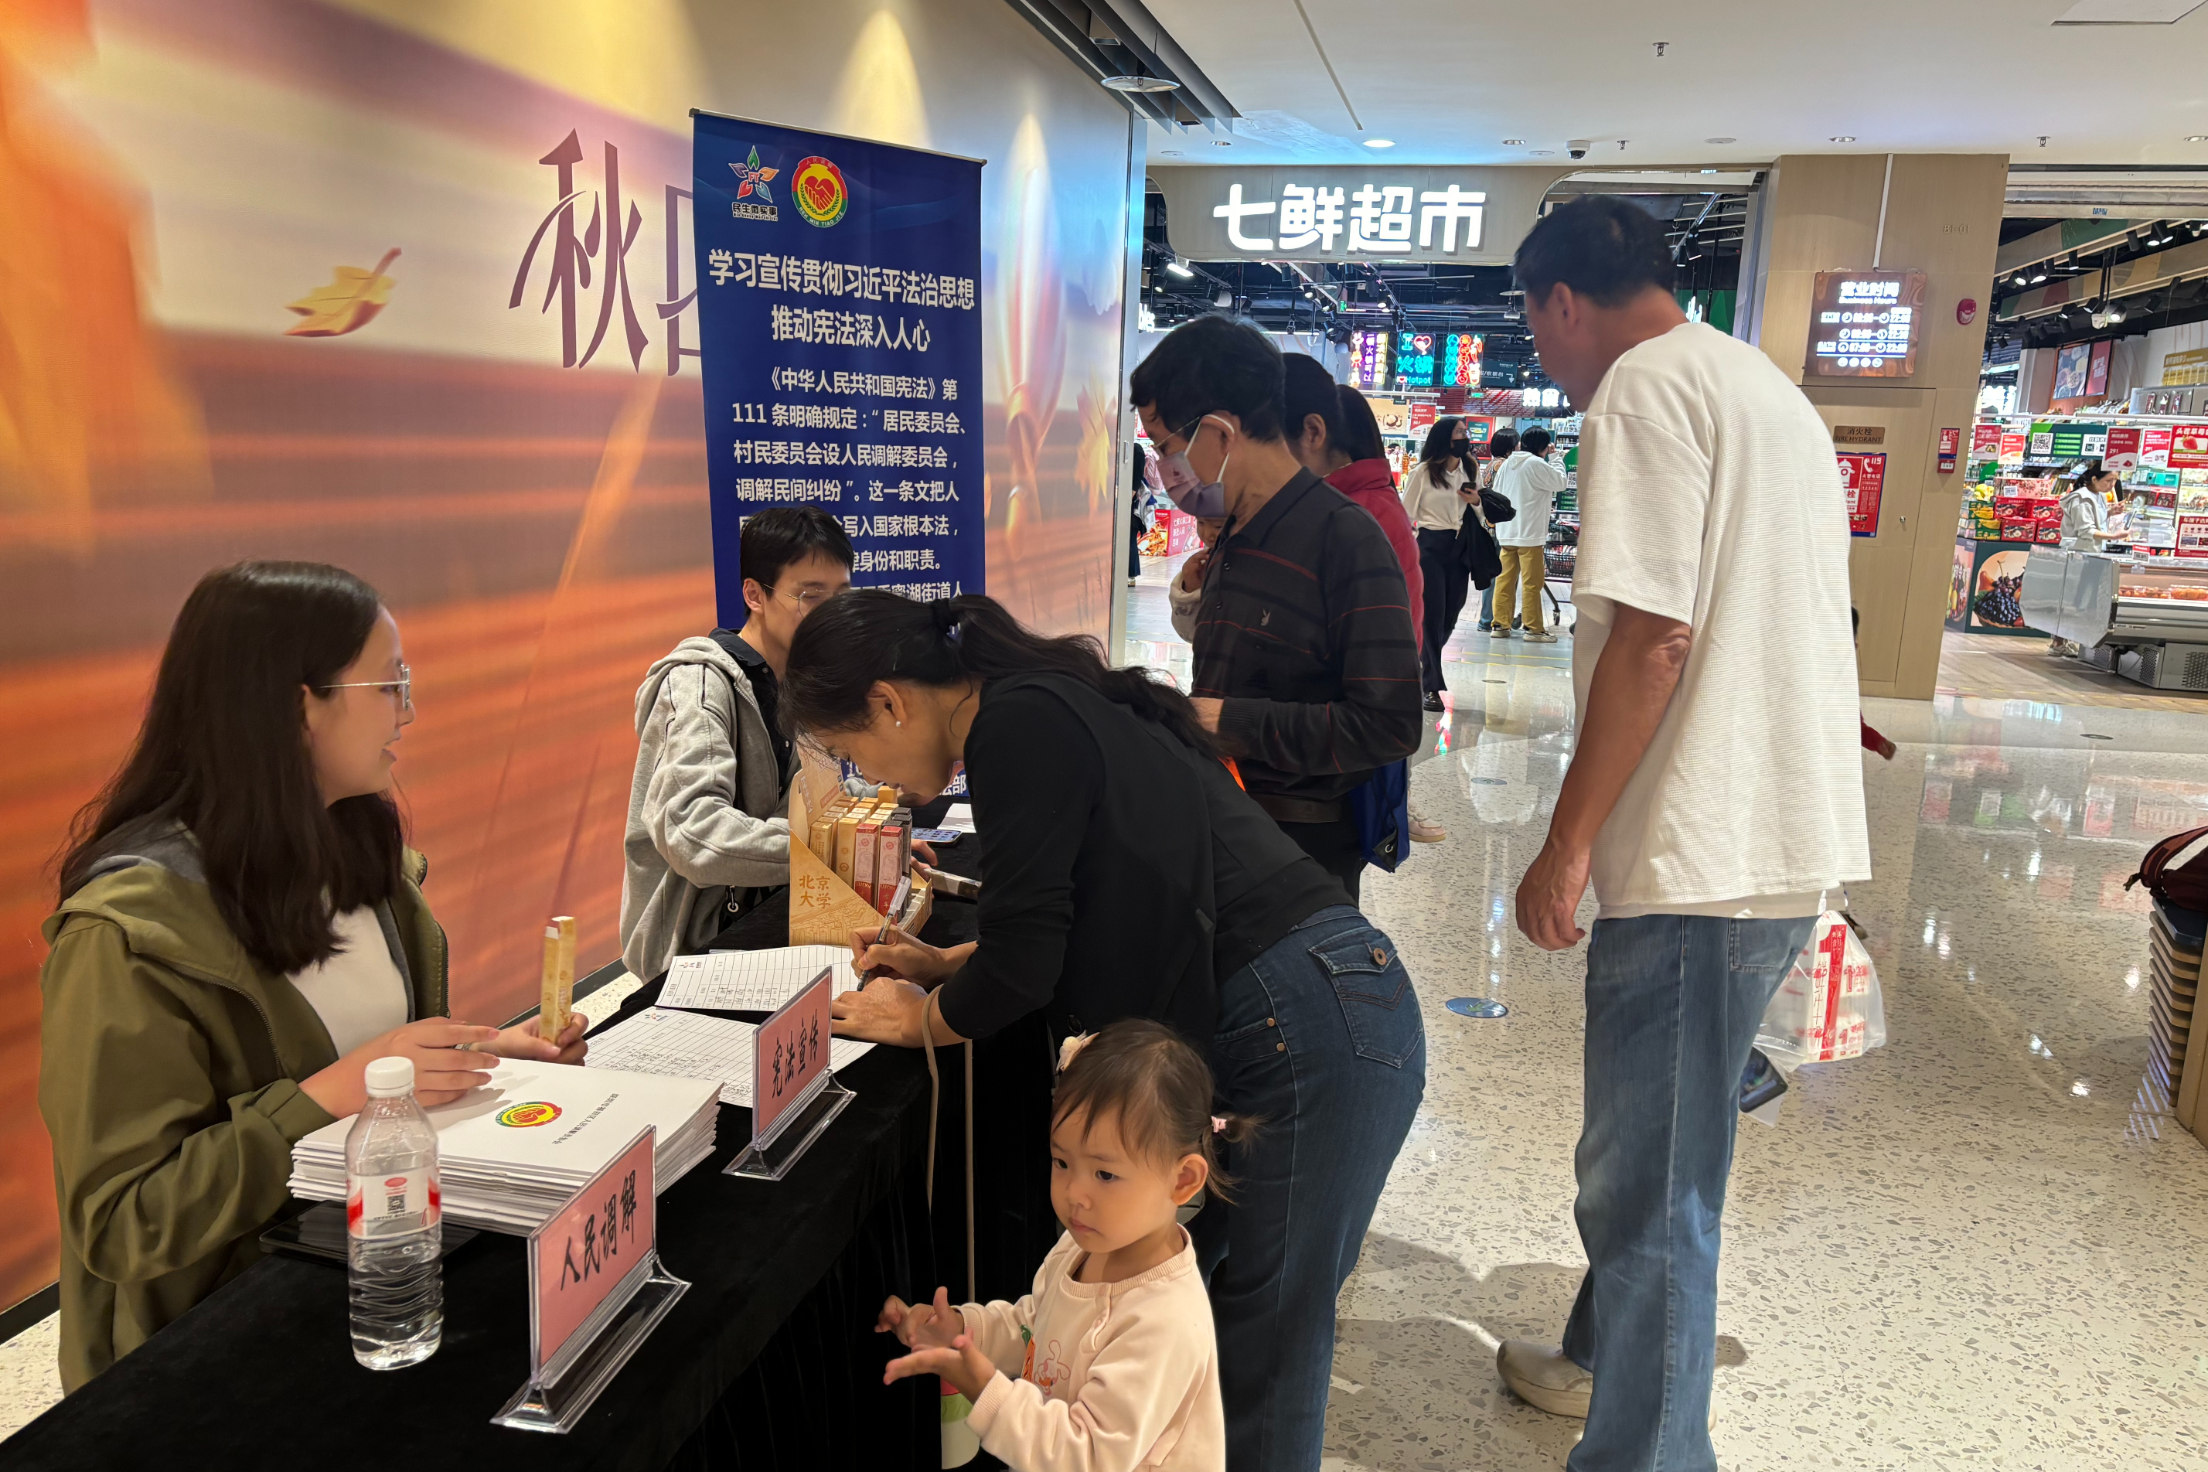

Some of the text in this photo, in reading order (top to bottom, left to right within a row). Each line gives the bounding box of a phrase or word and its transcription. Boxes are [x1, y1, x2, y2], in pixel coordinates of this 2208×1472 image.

[748, 171, 760, 182] FT
[1213, 184, 1486, 251] 七鲜超市
[708, 249, 975, 310] 学习宣传贯彻习近平法治思想
[771, 304, 931, 352] 推动宪法深入人心
[771, 366, 958, 401] 《中华人民共和国宪法》第
[1847, 427, 1873, 435] 消火栓
[733, 439, 957, 469] 村民委员会设人民调解委员会，
[799, 874, 831, 891] 北京
[800, 891, 832, 909] 大学
[772, 1008, 819, 1098] 宪法宣传
[560, 1169, 637, 1291] 人民调解
